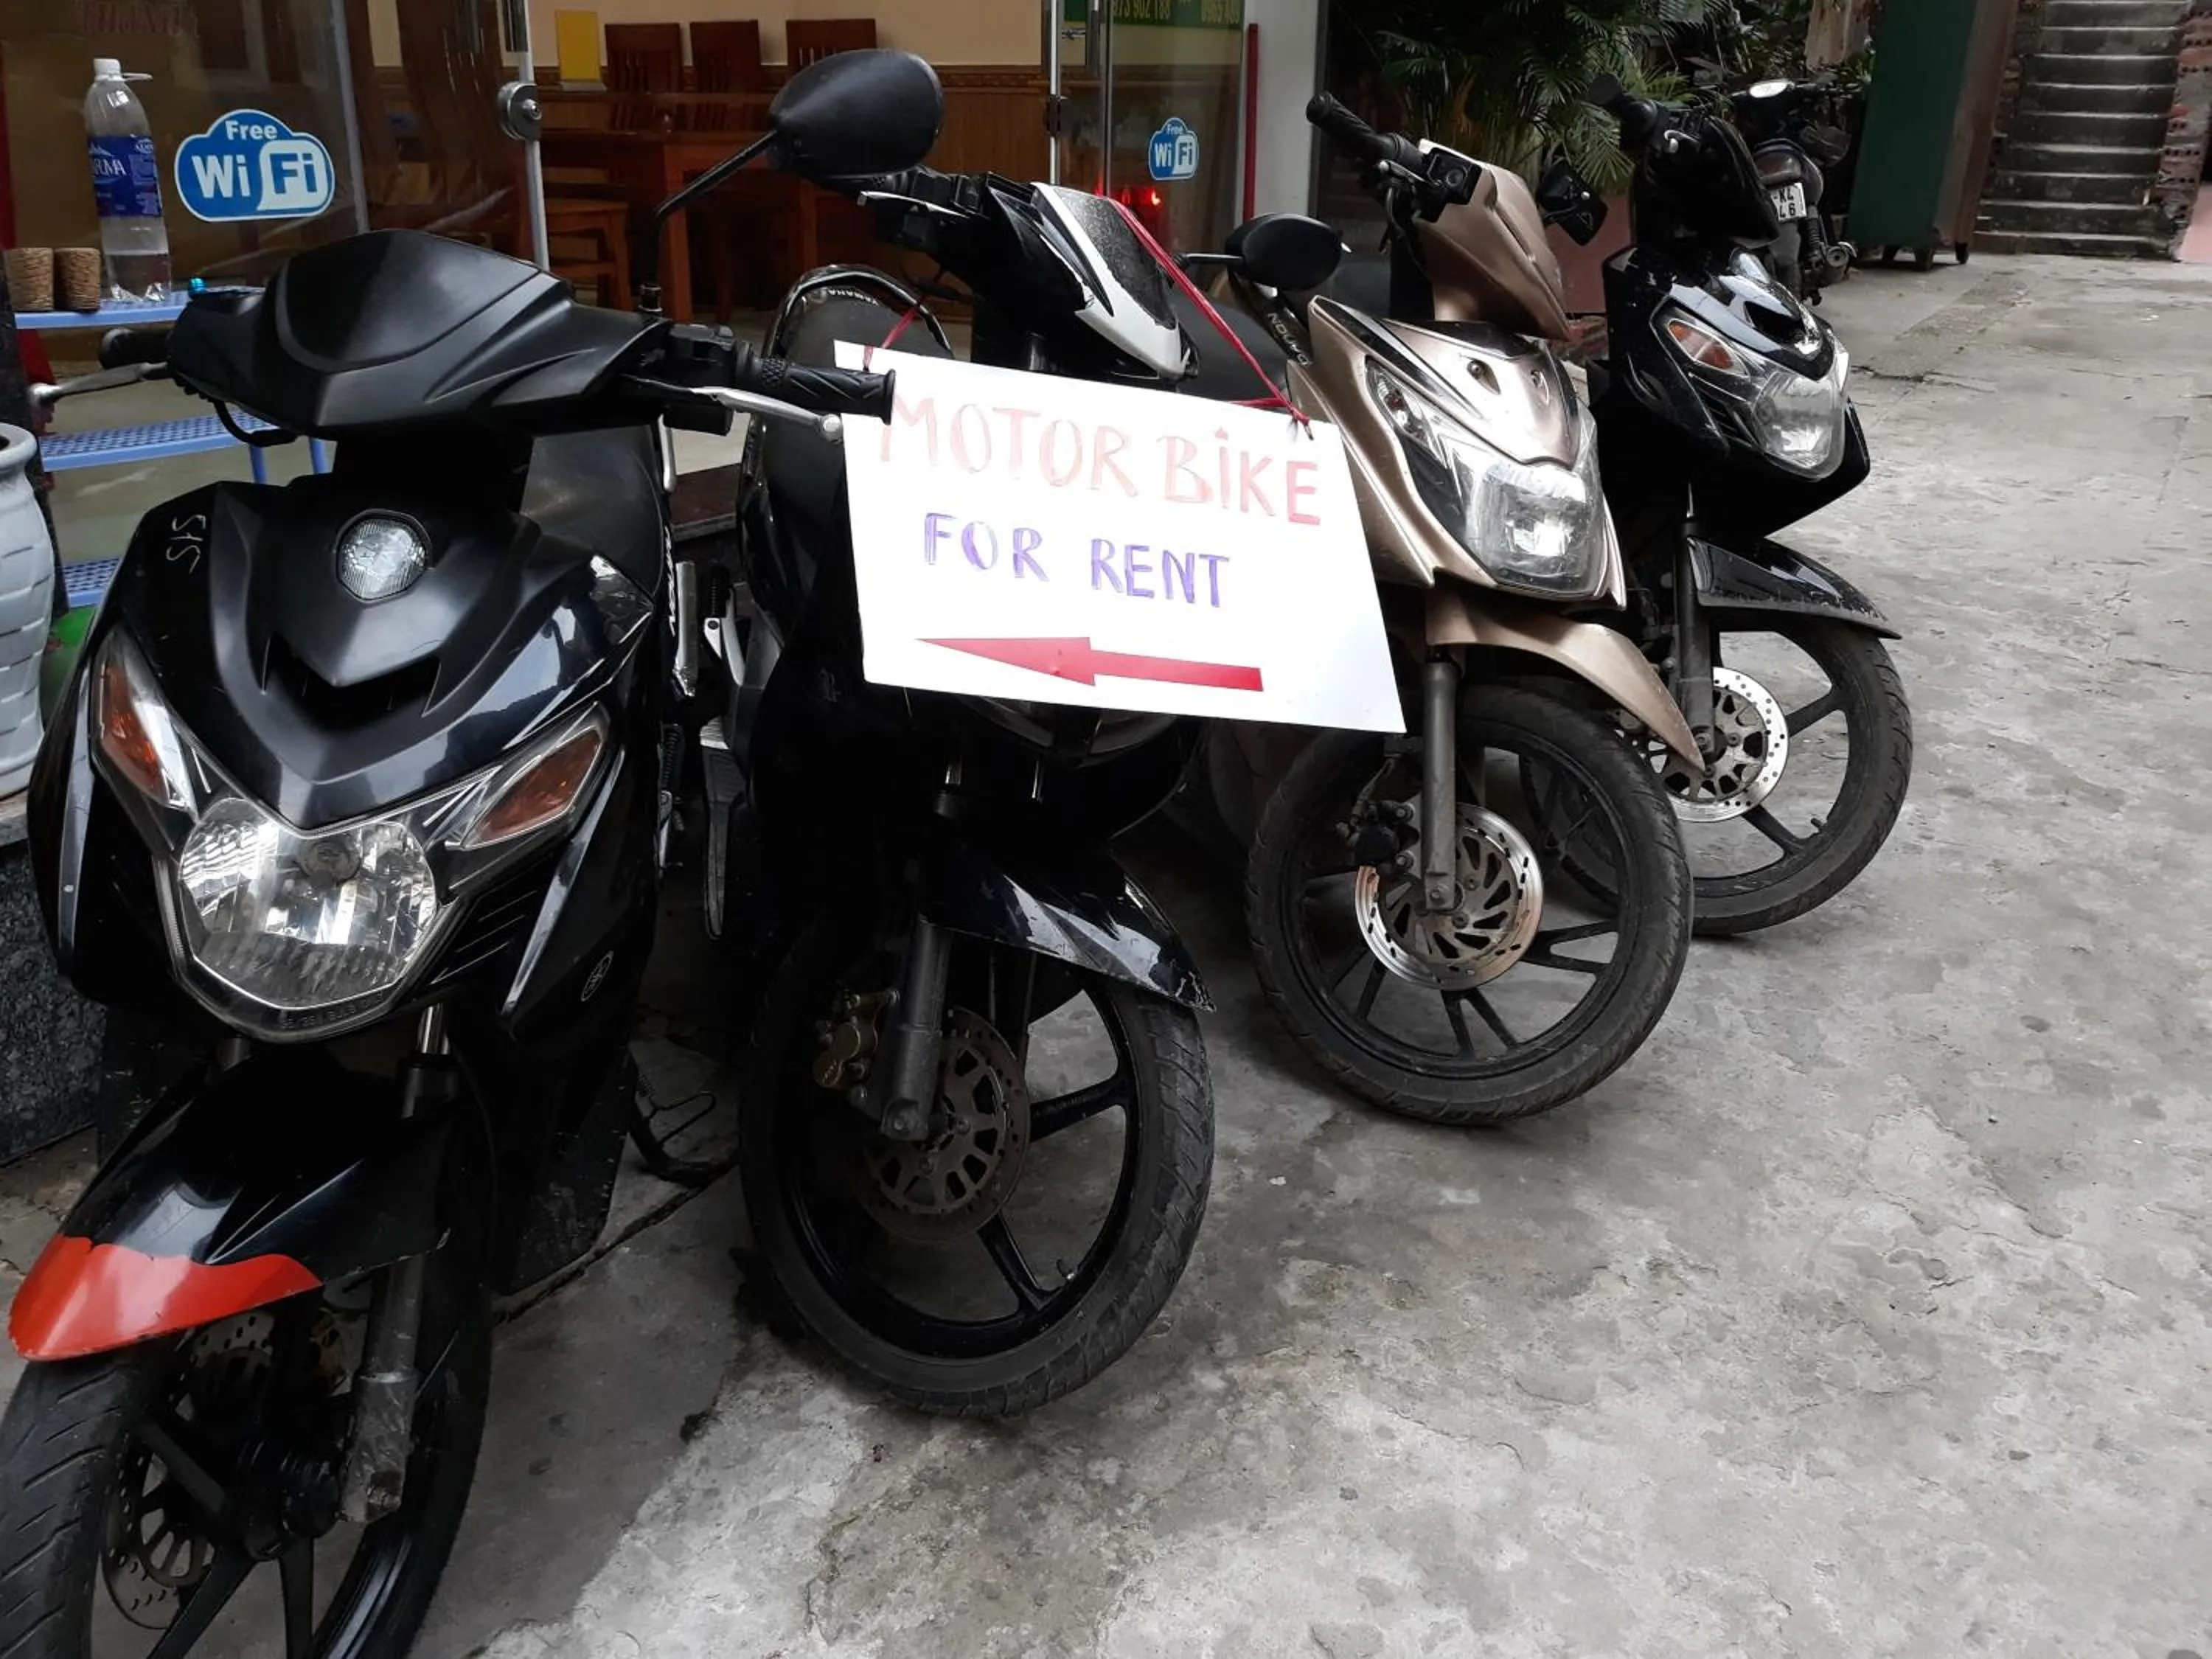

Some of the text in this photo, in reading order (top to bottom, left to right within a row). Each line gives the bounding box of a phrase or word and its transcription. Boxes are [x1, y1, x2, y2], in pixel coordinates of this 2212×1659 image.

[225, 120, 278, 140] Free
[880, 394, 1139, 498] MOTOR
[925, 512, 1231, 608] FOR RENT
